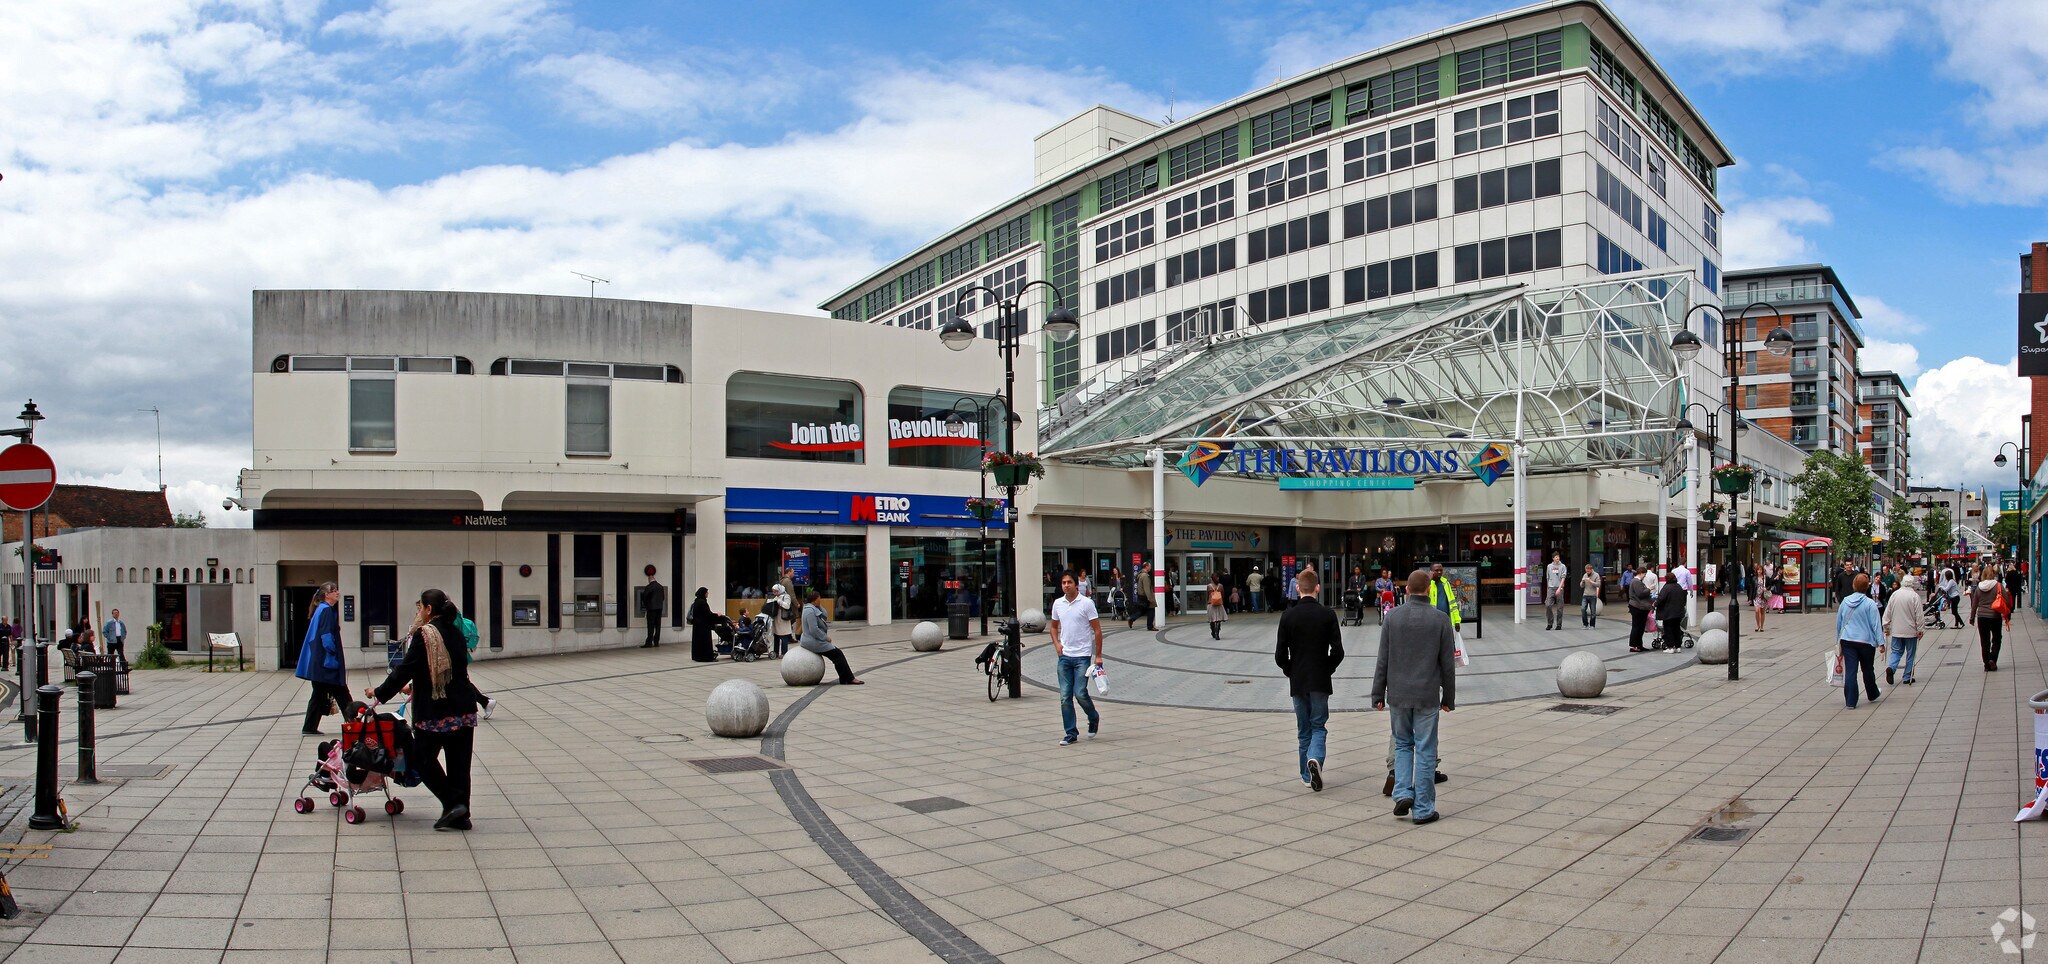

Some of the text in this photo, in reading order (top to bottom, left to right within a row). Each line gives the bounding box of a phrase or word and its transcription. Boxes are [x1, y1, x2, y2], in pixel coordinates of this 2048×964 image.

[790, 421, 860, 445] Join the
[888, 417, 979, 439] Revoluon
[1232, 448, 1459, 474] THE PAVILIONS
[1357, 479, 1391, 487] CENTRE
[851, 495, 910, 522] METRO
[2007, 500, 2019, 510] £1
[465, 515, 507, 526] NatWest
[877, 512, 910, 522] BANK
[1175, 528, 1246, 541] THE PAVILIONS
[1473, 533, 1513, 545] COSTA
